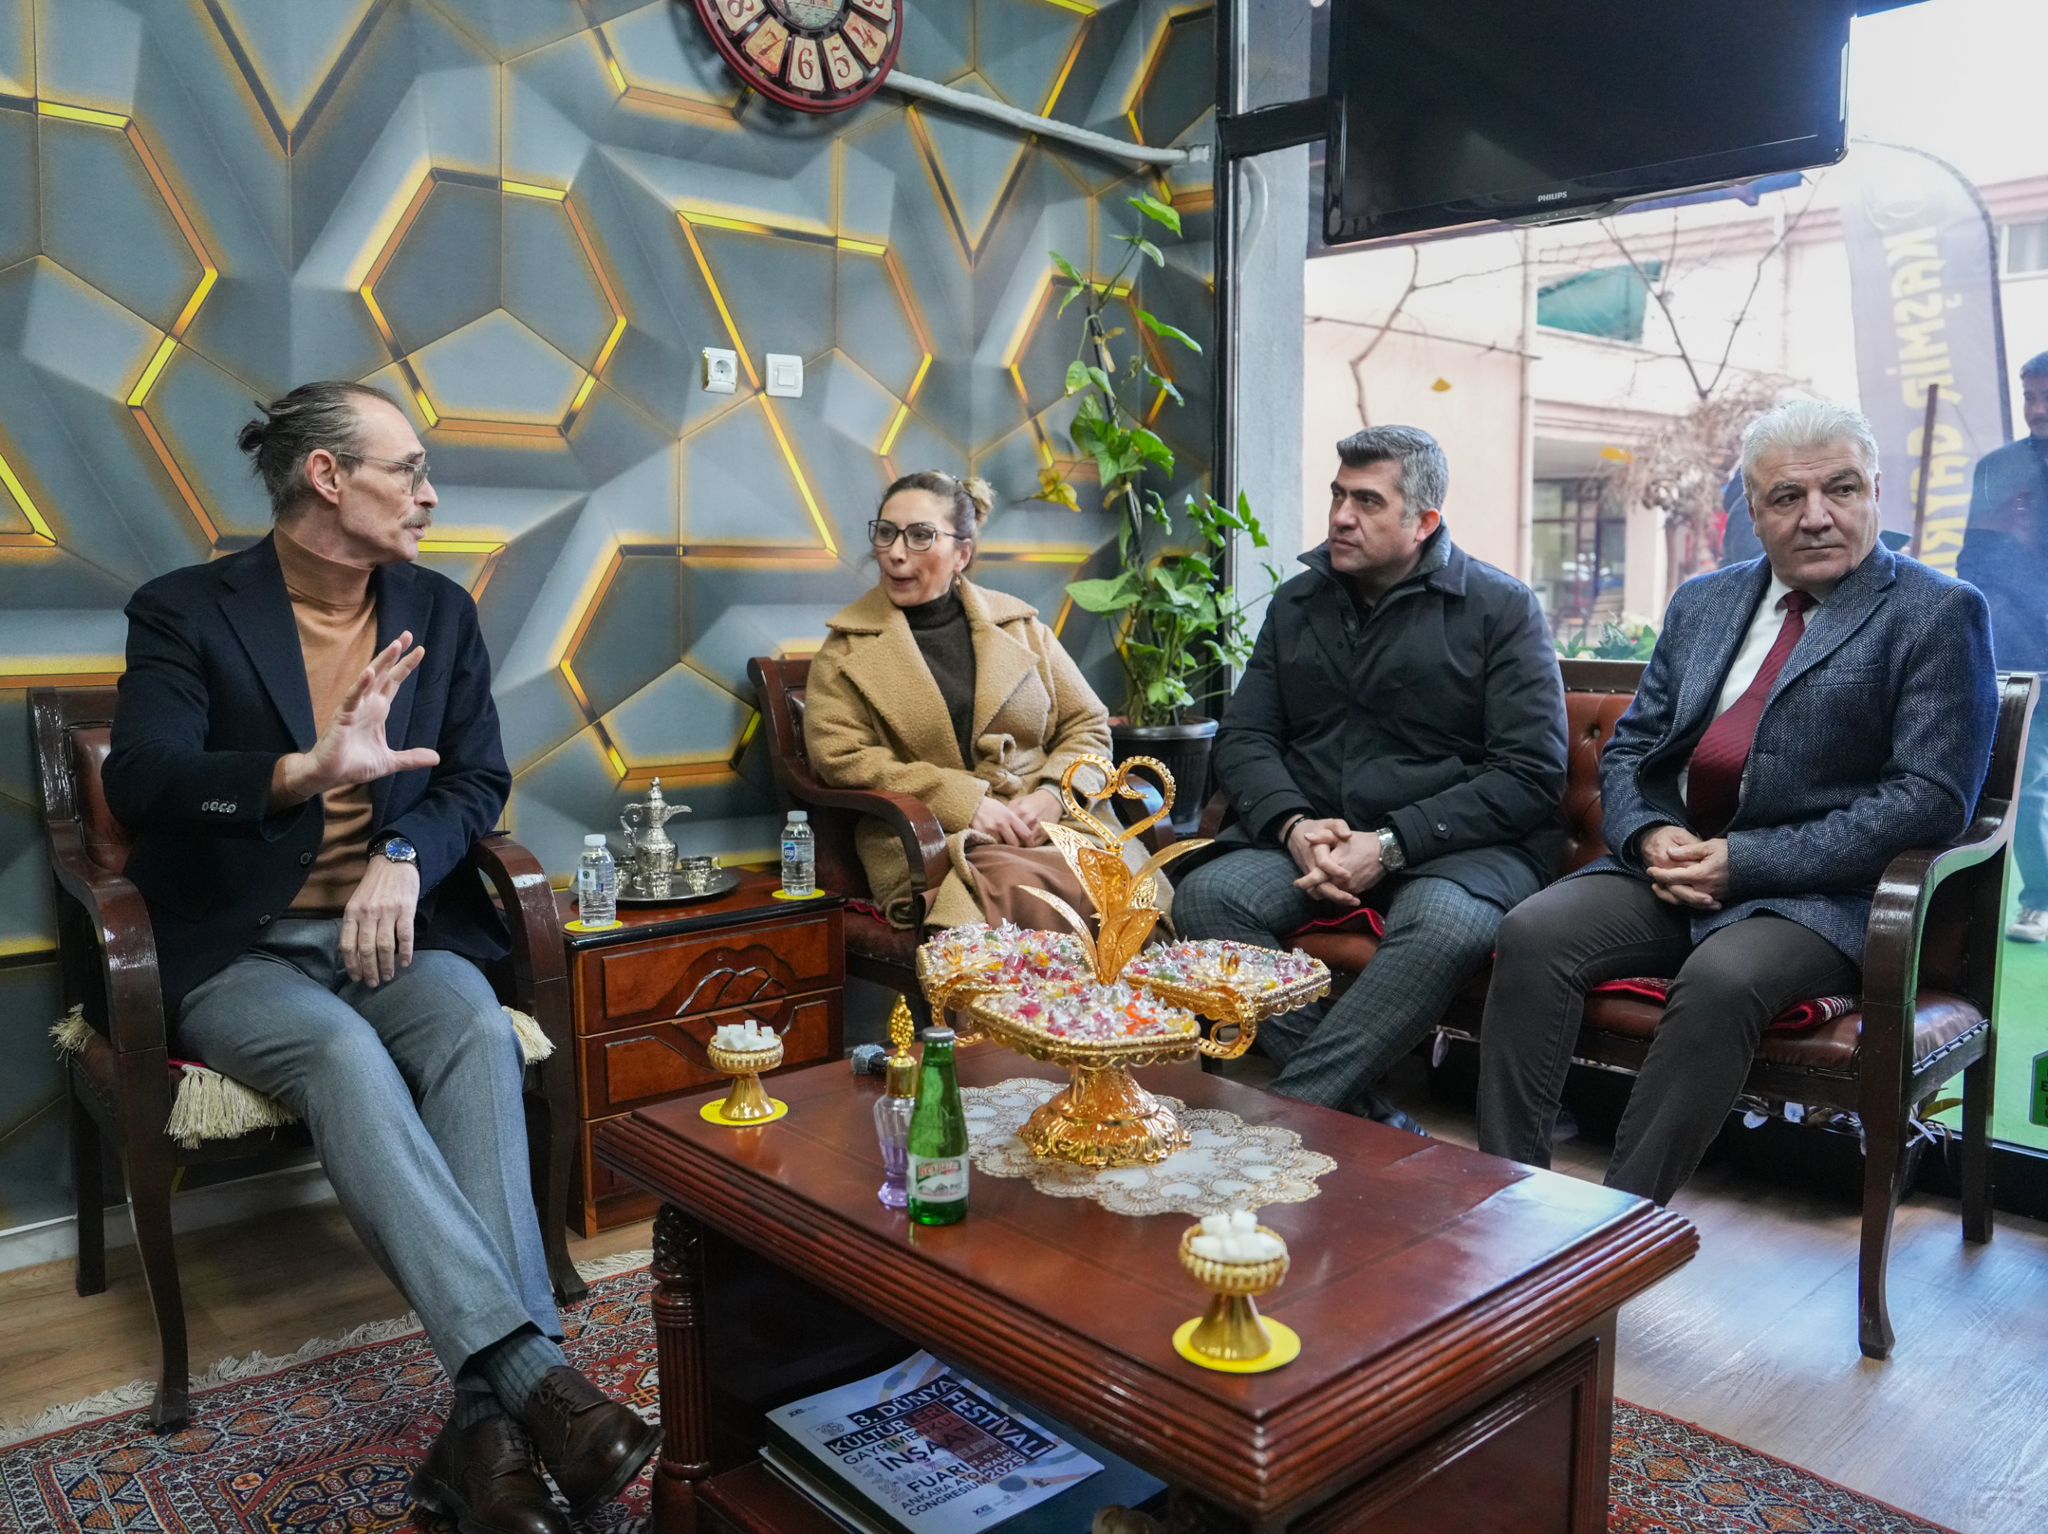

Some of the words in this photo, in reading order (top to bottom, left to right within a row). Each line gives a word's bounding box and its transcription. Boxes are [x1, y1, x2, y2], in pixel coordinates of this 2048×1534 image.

[759, 28, 783, 57] 7
[851, 25, 878, 49] 4
[797, 47, 814, 79] 6
[831, 44, 851, 78] 5
[1537, 191, 1567, 202] PHILIPS
[853, 1414, 878, 1426] 3.
[878, 1380, 957, 1416] DÜNYA
[943, 1390, 1054, 1458] FESTİVALİ
[875, 1424, 975, 1472] İNŞAAT
[907, 1462, 970, 1493] FUARI
[985, 1456, 1026, 1479] 2025
[901, 1484, 953, 1509] ANKARA
[956, 1471, 979, 1486] ATO
[908, 1477, 991, 1516] CONGRESIUM
